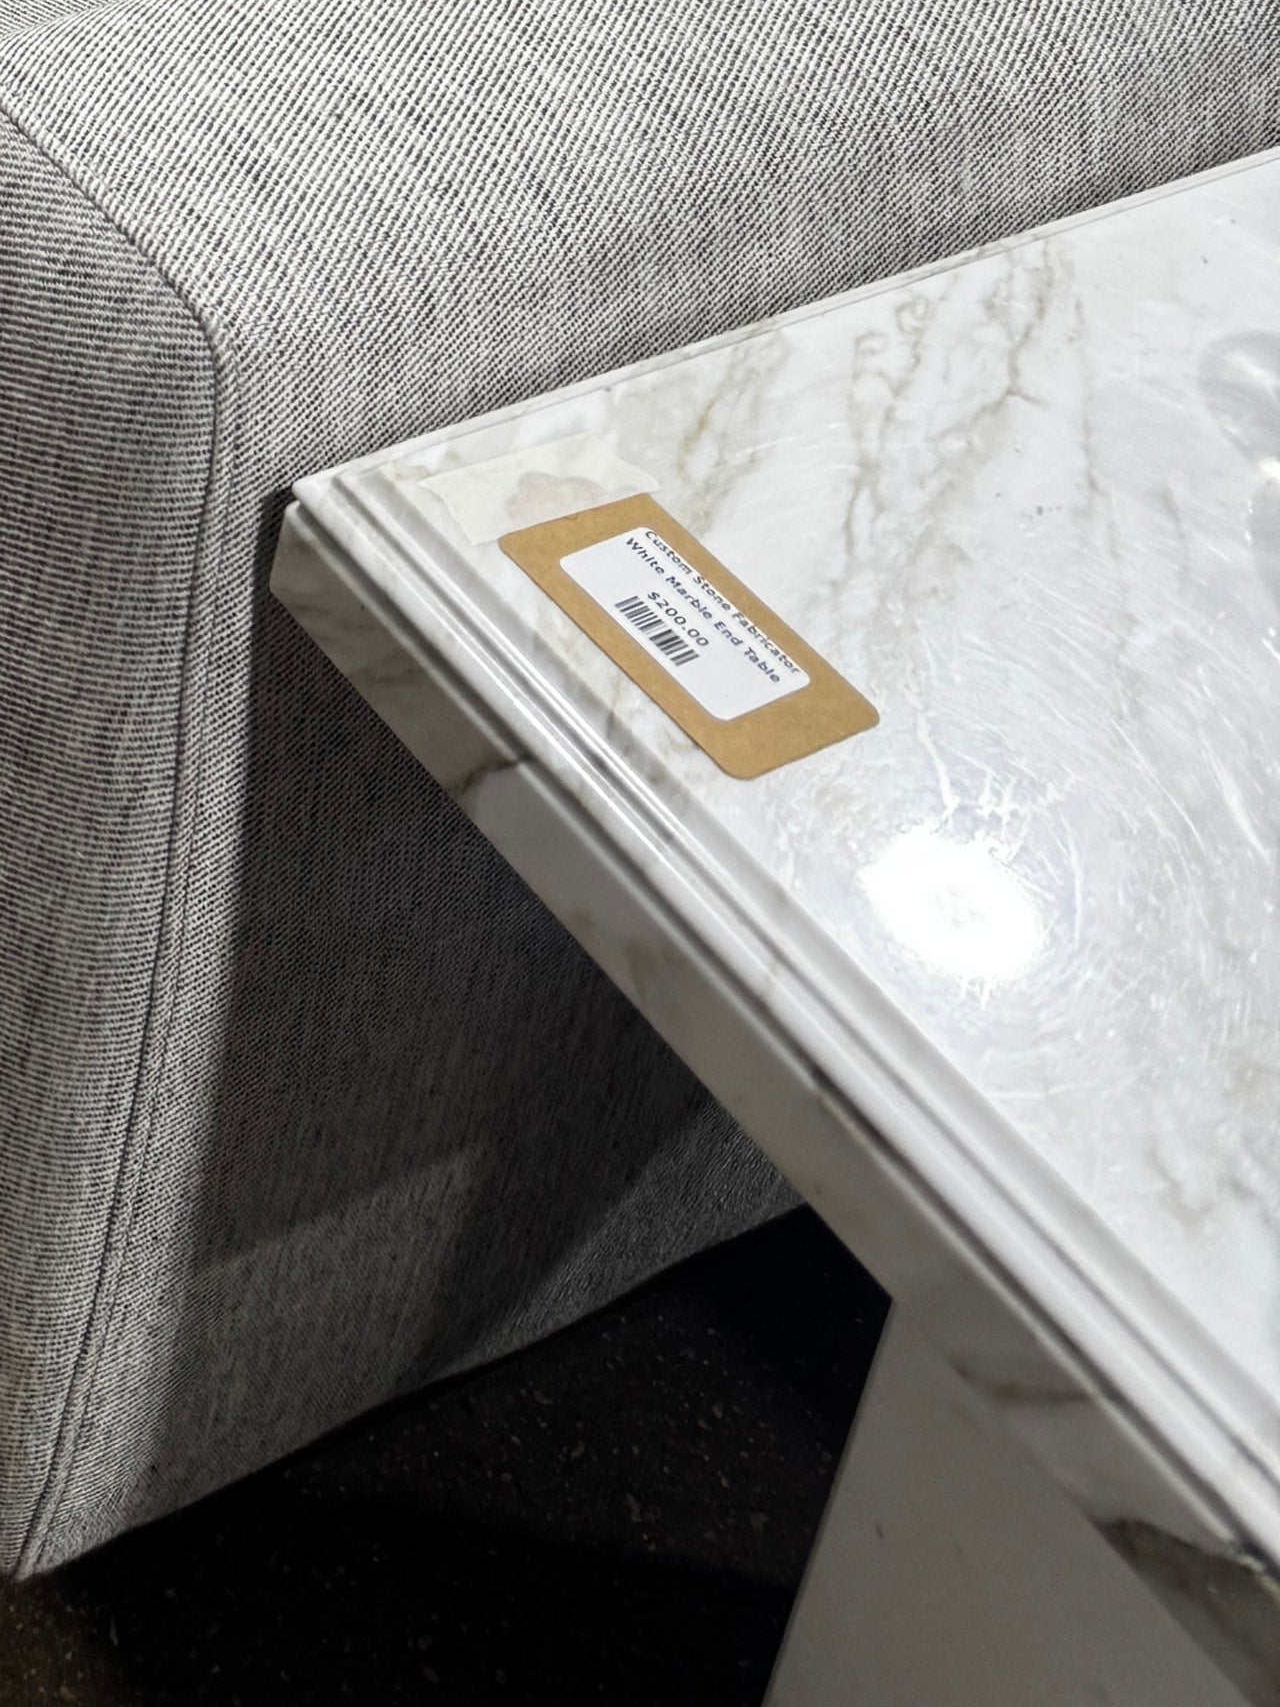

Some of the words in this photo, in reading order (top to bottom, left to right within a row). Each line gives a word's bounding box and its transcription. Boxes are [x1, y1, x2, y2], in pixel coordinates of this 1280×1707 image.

[626, 537, 665, 575] White
[665, 576, 713, 620] Marble
[714, 620, 744, 647] End
[744, 646, 780, 683] Table
[645, 530, 693, 575] Custom
[692, 575, 732, 611] Stone
[732, 611, 801, 674] Fabricator
[647, 591, 709, 647] $200.00
